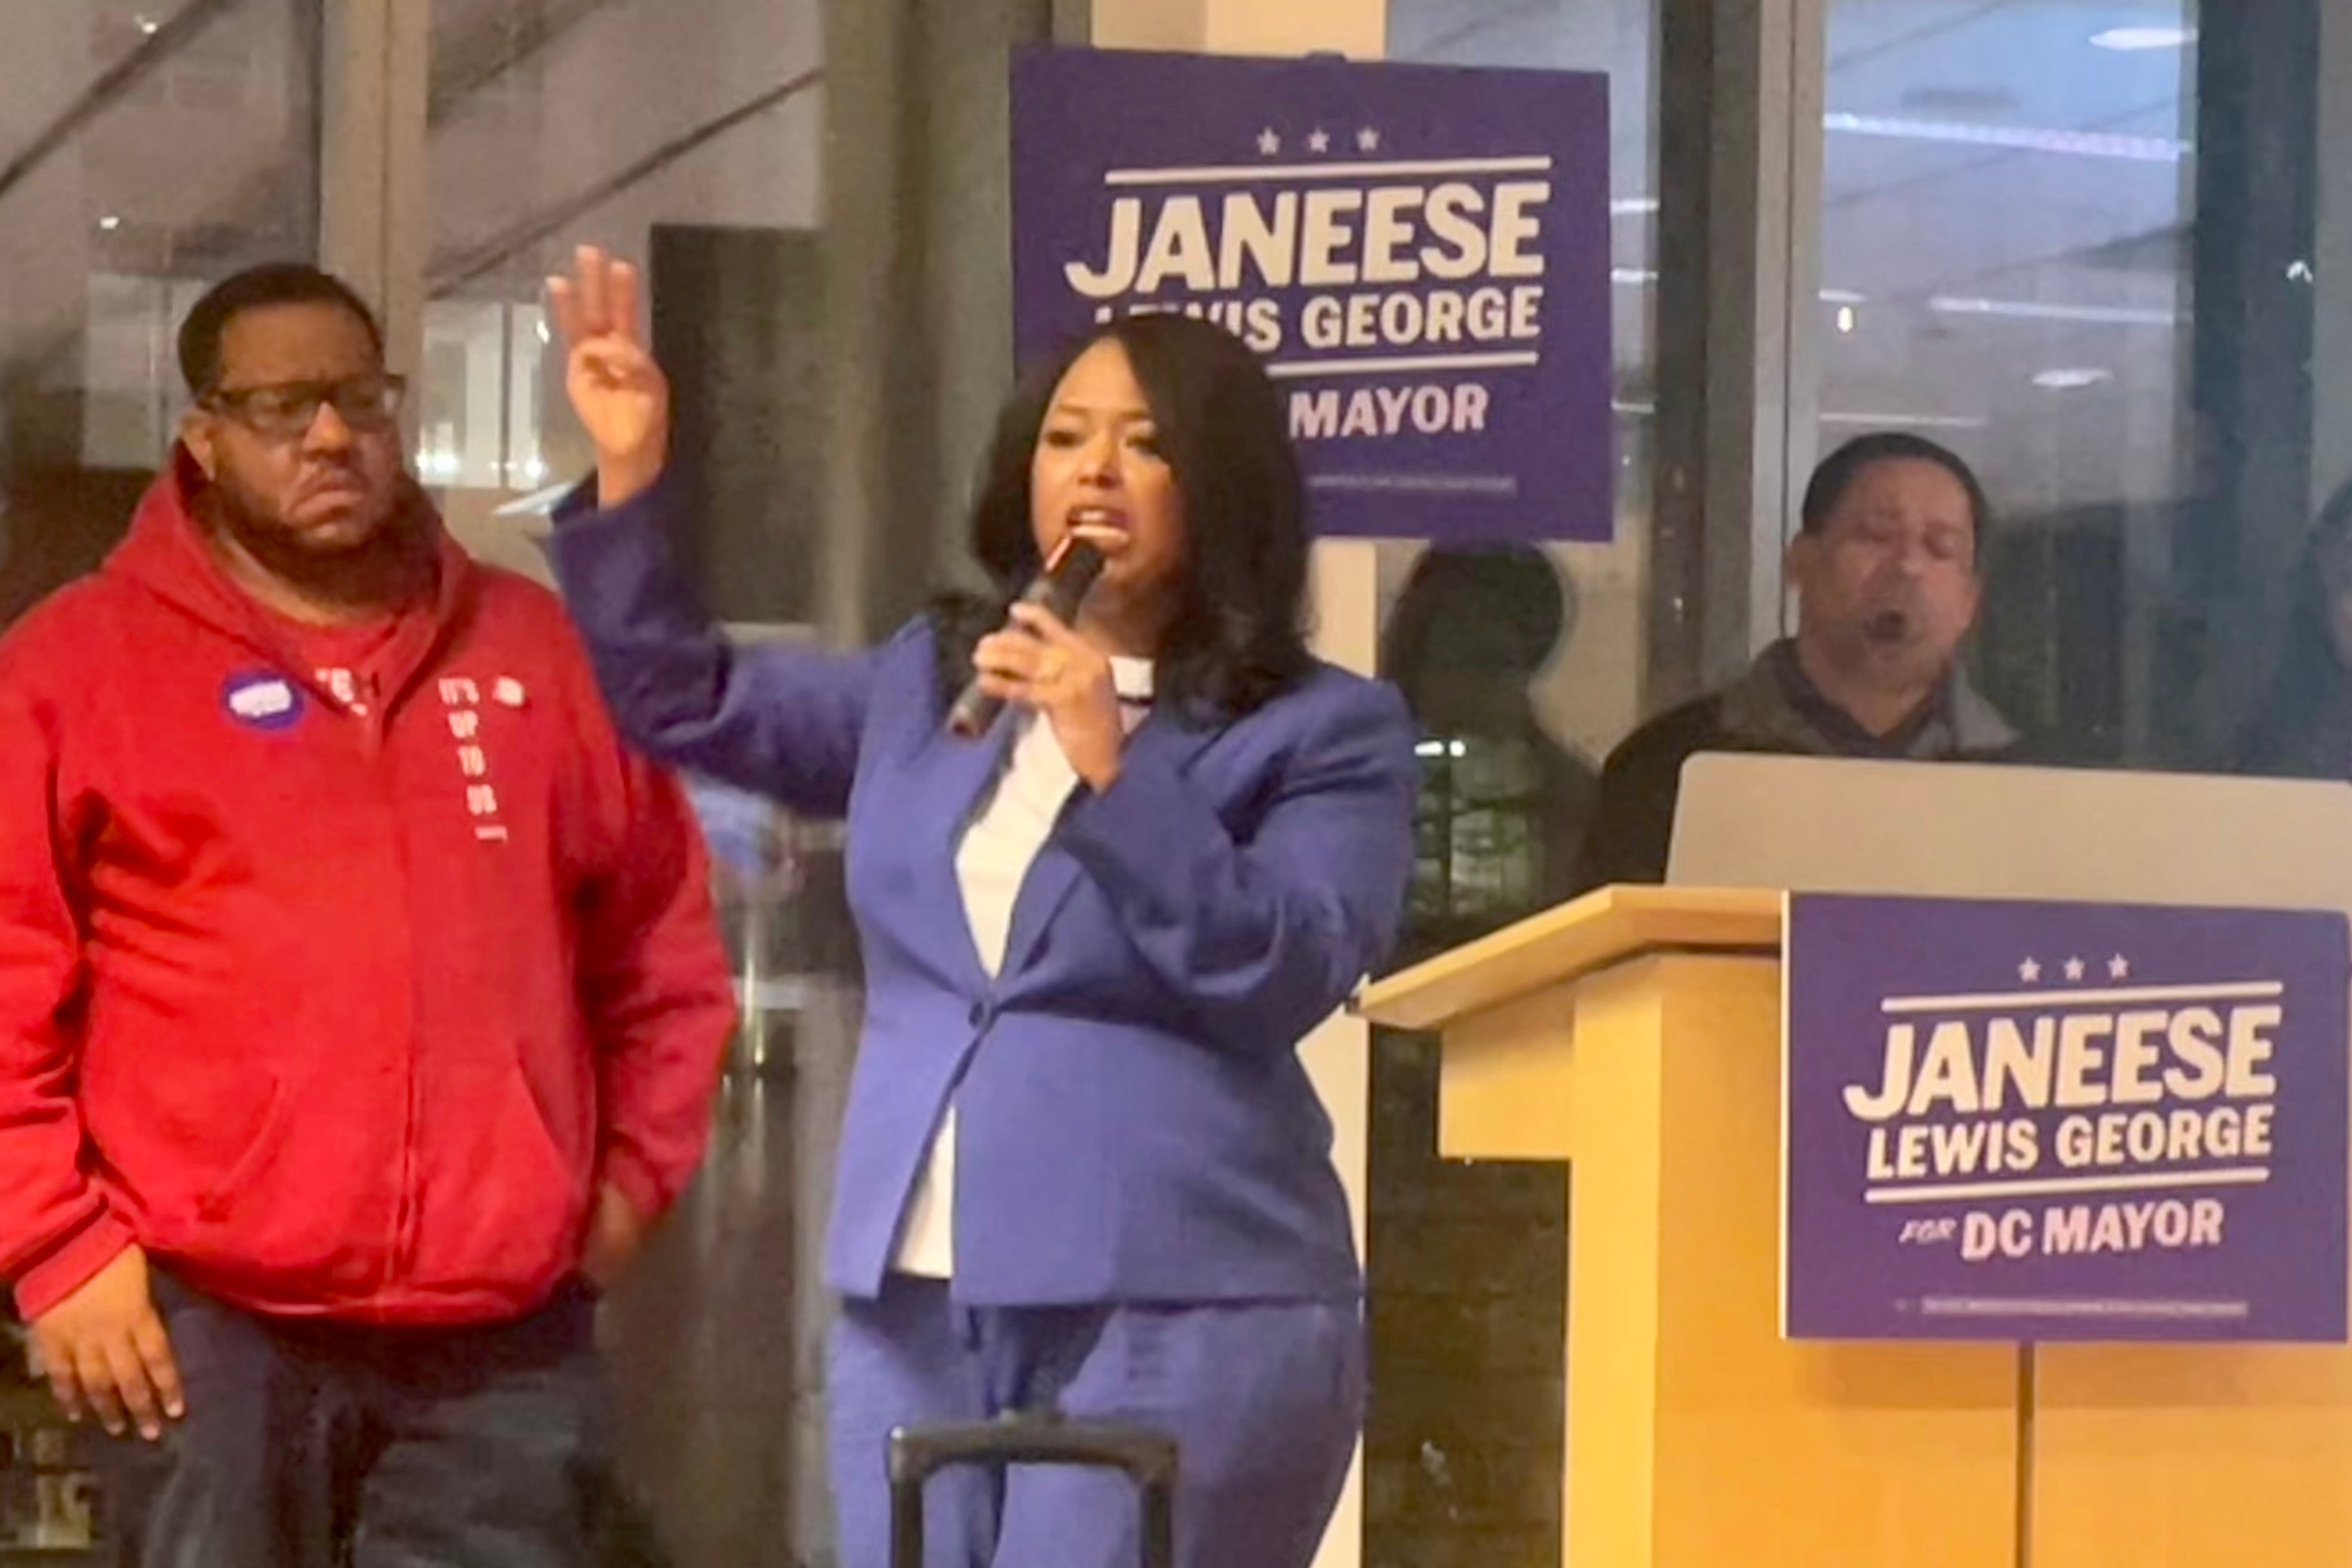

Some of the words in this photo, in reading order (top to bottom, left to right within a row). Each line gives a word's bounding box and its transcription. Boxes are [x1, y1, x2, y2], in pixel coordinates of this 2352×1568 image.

[1064, 182, 1551, 298] JANEESE
[1301, 287, 1544, 349] GEORGE
[1290, 383, 1489, 439] MAYOR
[1843, 1005, 2282, 1119] JANEESE
[1867, 1121, 2038, 1180] LEWIS
[2055, 1103, 2275, 1167] GEORGE
[1899, 1219, 1956, 1244] FOR
[1961, 1210, 2032, 1261] DC
[2042, 1198, 2224, 1255] MAYOR
